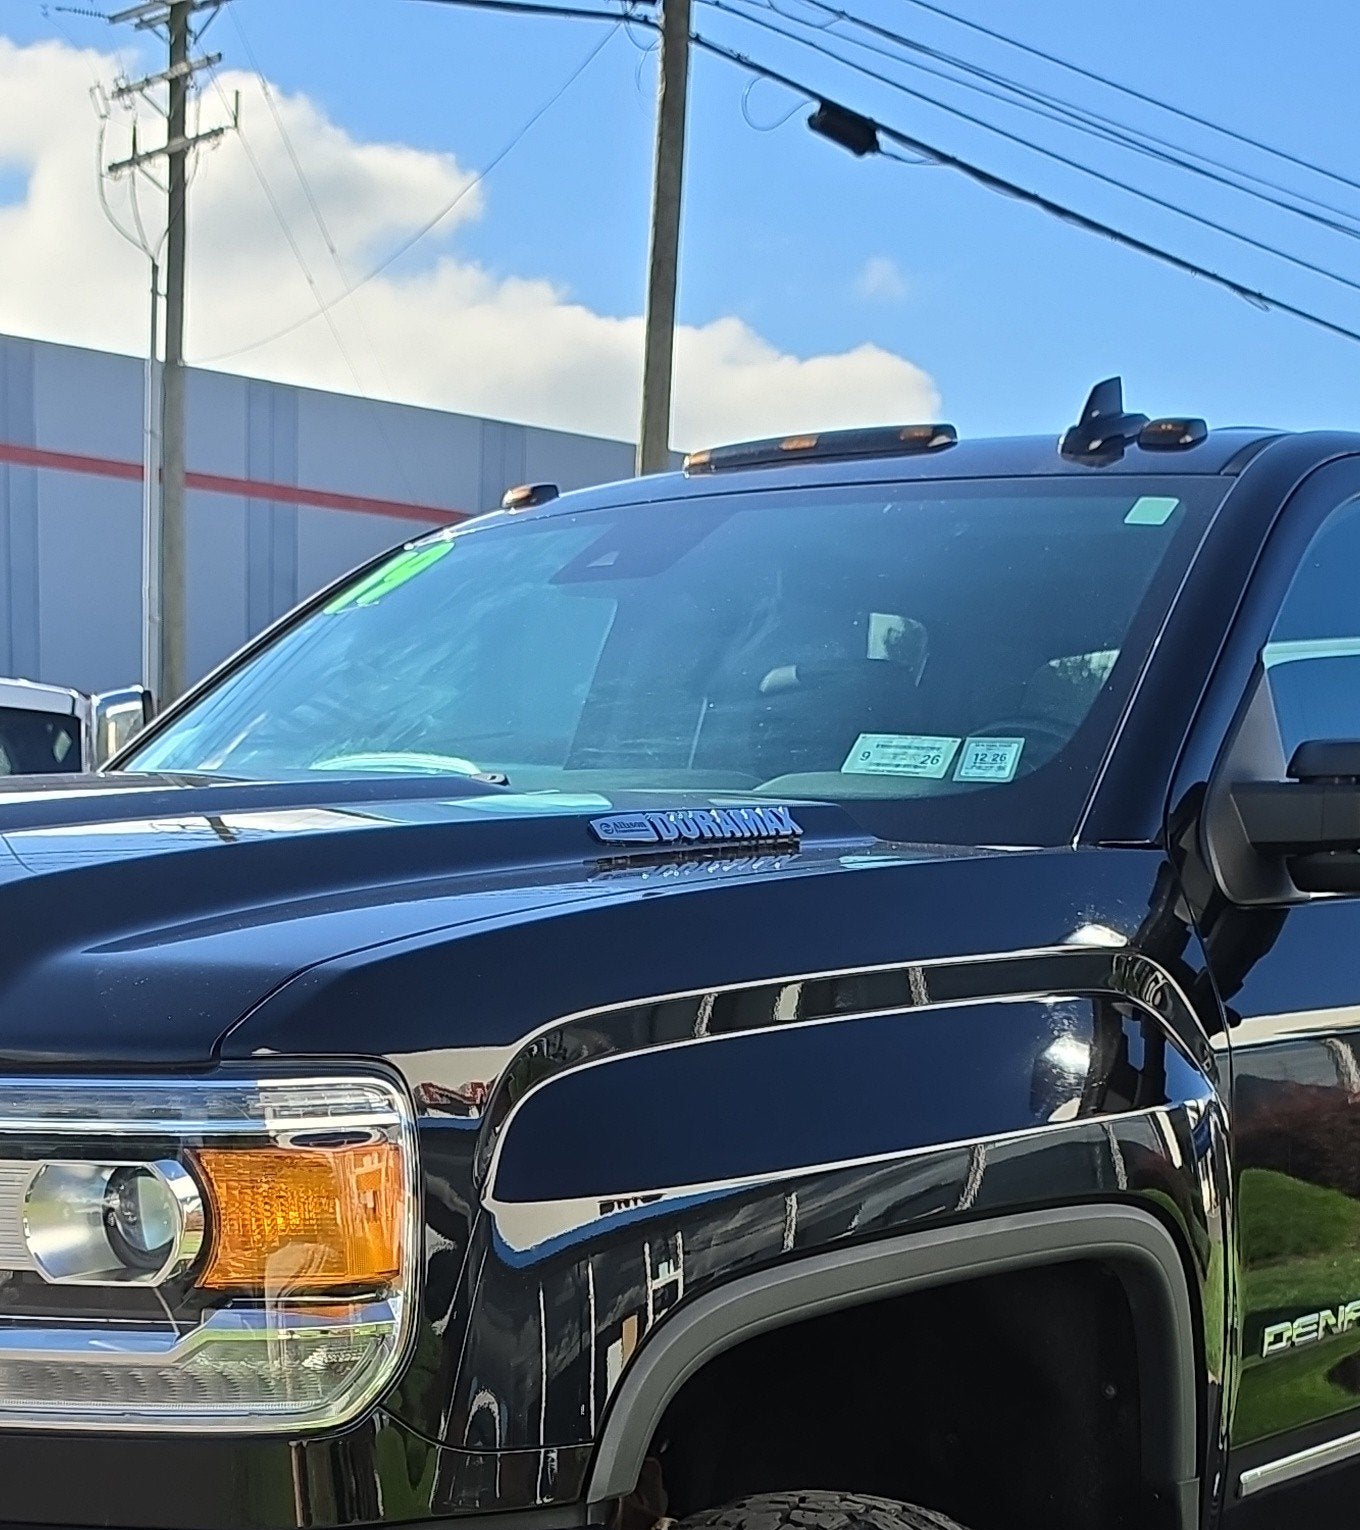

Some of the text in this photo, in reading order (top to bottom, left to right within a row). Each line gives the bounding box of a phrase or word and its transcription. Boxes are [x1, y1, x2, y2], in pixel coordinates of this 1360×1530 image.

[920, 754, 941, 765] 26
[974, 753, 1007, 762] 12 26
[643, 805, 804, 843] DURAMAX
